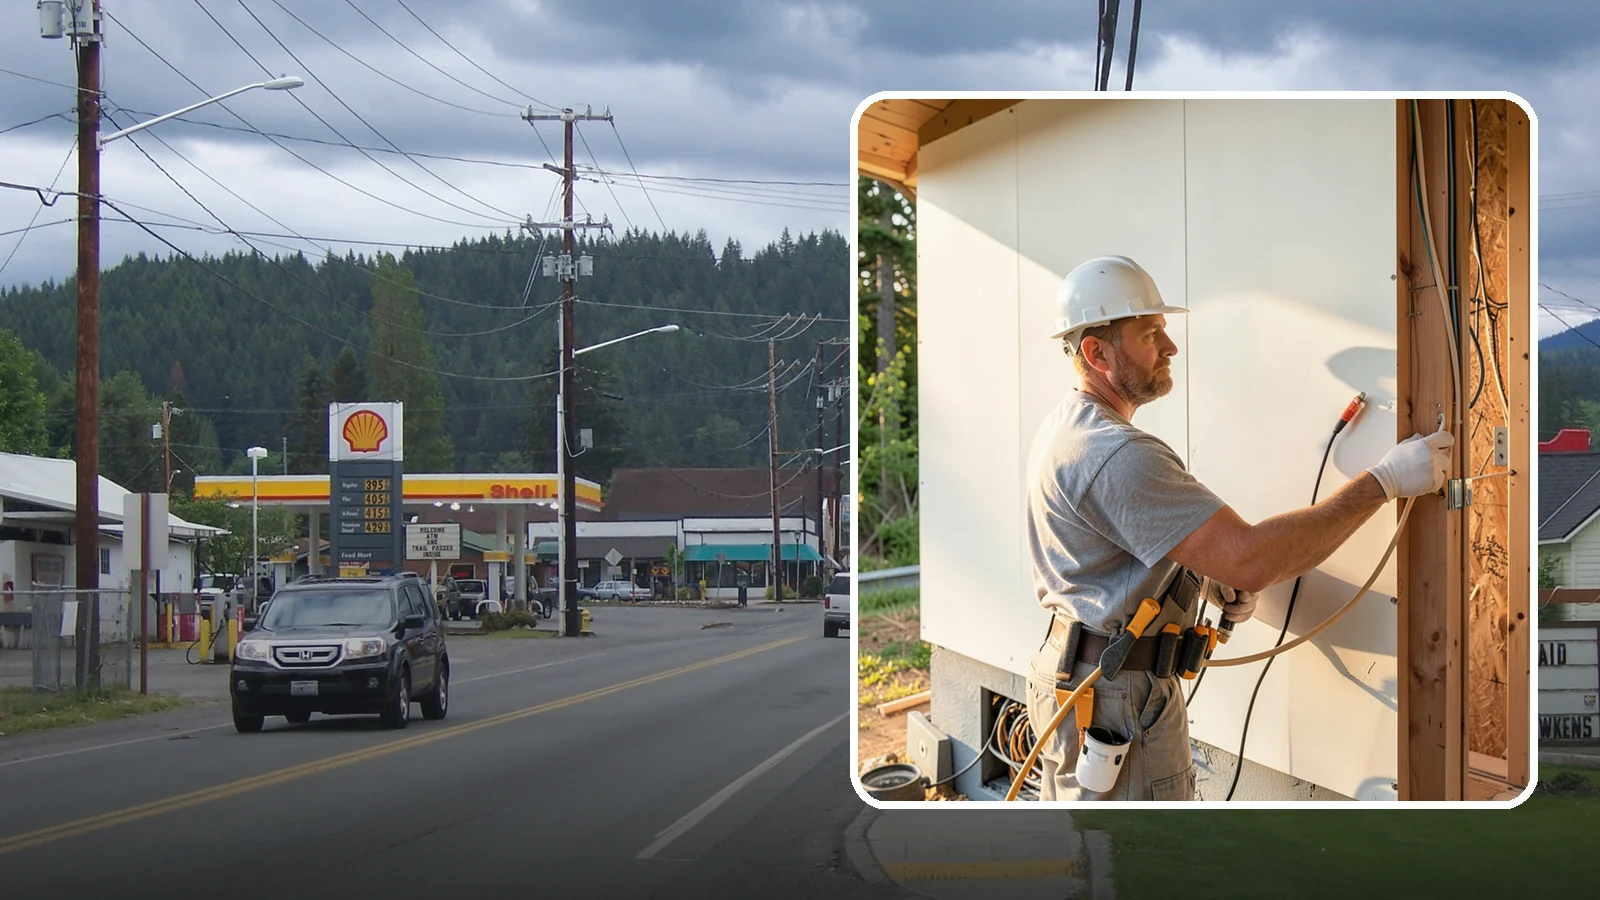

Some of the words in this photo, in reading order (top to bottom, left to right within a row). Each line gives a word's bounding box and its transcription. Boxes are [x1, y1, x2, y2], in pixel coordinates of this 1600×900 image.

[366, 480, 384, 490] 395
[490, 484, 547, 499] Shell
[366, 494, 384, 504] 405
[366, 508, 383, 518] 415
[366, 522, 384, 532] 429
